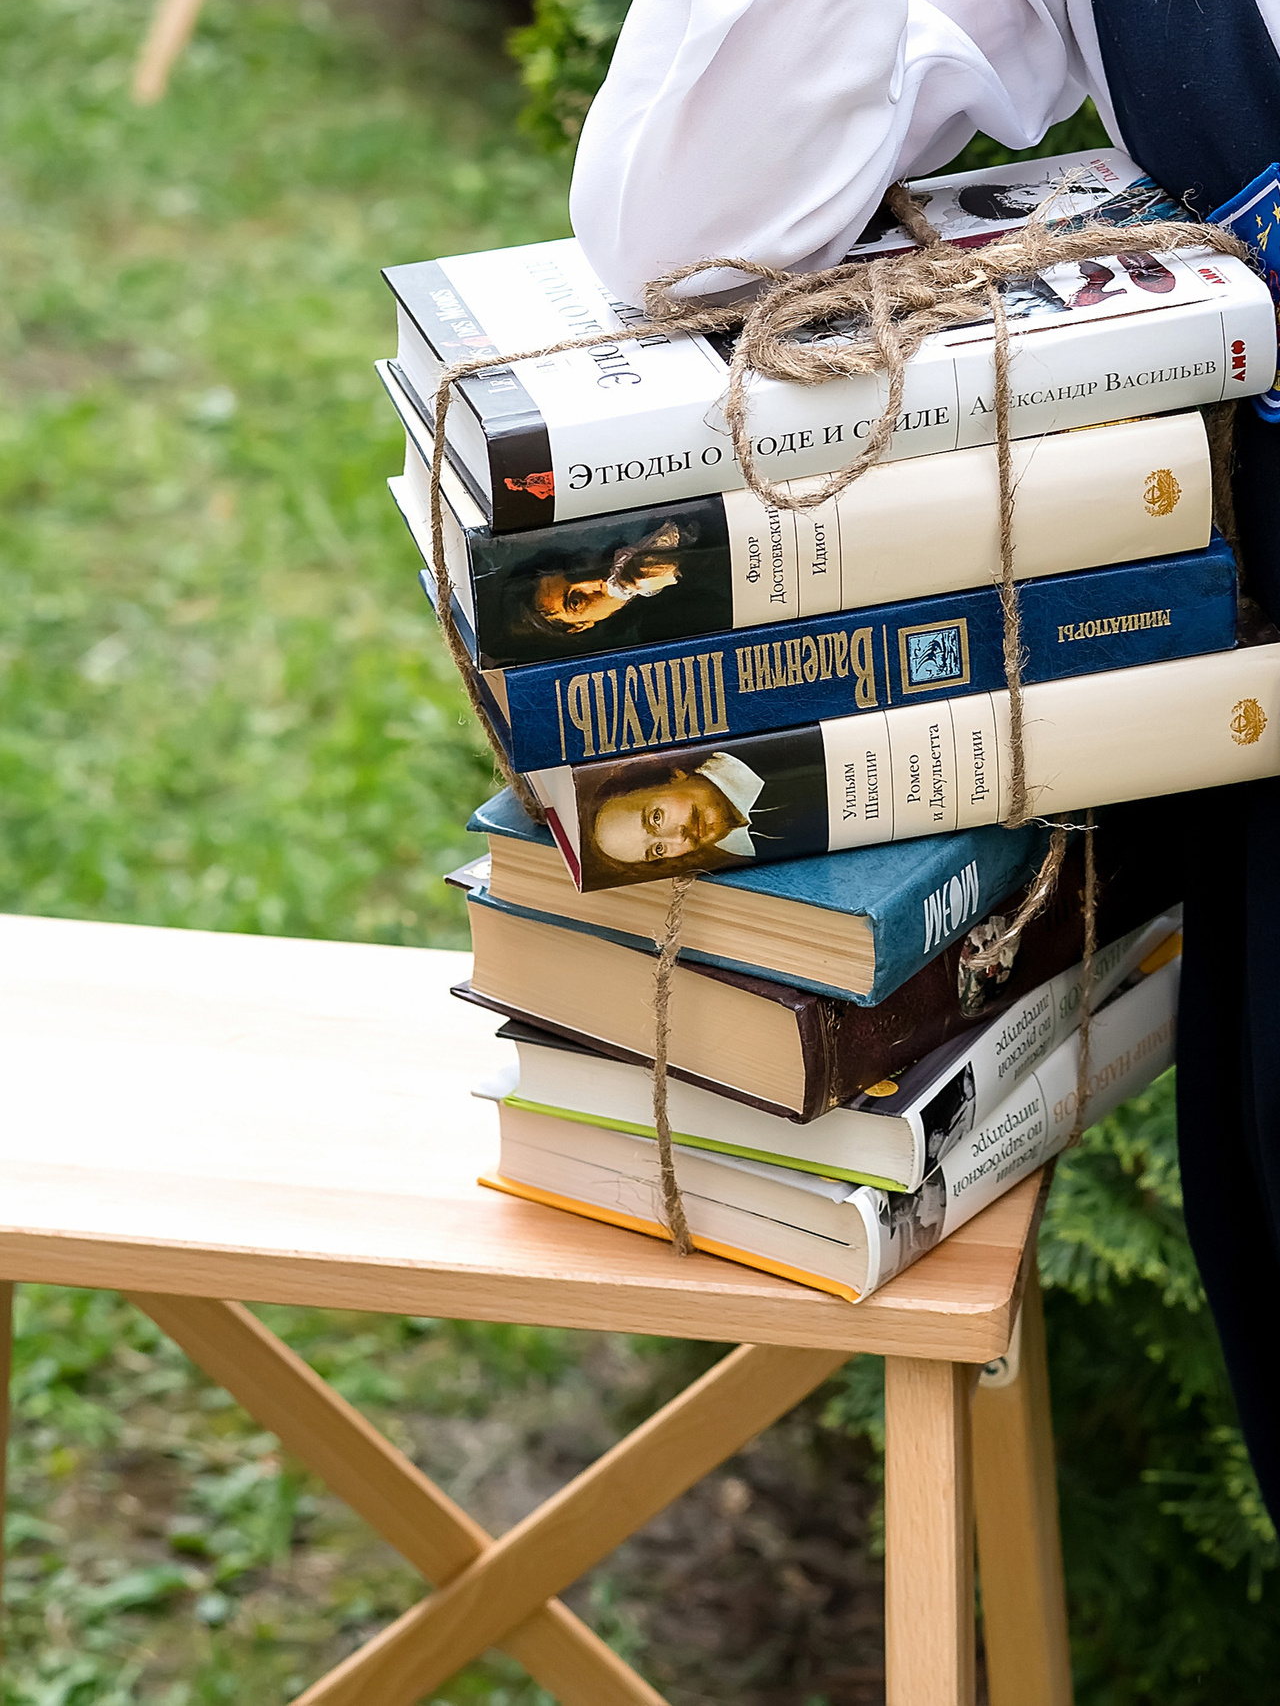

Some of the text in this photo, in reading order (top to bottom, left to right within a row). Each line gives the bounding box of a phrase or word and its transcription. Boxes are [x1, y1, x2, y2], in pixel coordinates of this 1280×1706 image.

[1104, 359, 1217, 393] ВАСИЛЬЕВ
[568, 448, 693, 491] ЭТЮДЫ
[745, 535, 762, 584] ФЕДОР
[811, 522, 829, 576] Идиот
[1056, 608, 1172, 644] МИНИАТЮРЫ
[566, 650, 731, 758] ПИКУЛЬ
[842, 762, 858, 822] УИЛЬЯМ
[864, 749, 880, 821] ШЕКСПИР
[906, 753, 921, 805] Ромео
[929, 722, 948, 810] Джульетта
[970, 729, 990, 806] Трагедии
[995, 994, 1050, 1056] литературе
[971, 1098, 1040, 1158] литературе
[1026, 1120, 1043, 1141] по
